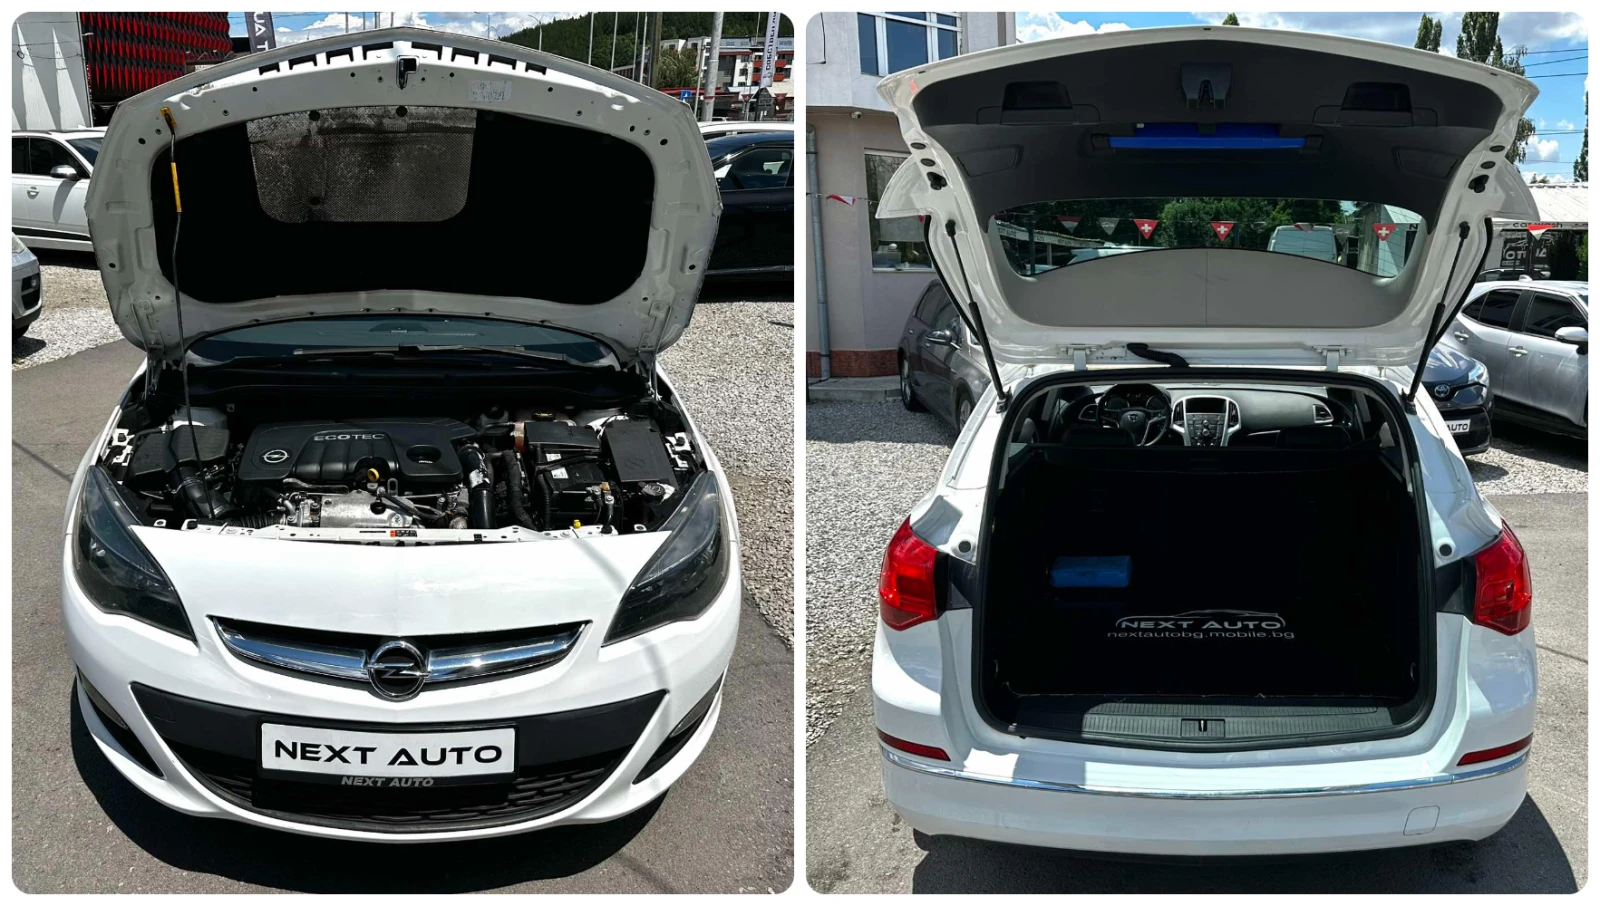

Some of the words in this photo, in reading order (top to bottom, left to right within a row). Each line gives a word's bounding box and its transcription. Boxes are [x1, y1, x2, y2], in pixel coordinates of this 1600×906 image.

[313, 433, 385, 441] ECOTEC
[274, 739, 377, 764] NEXT
[387, 745, 503, 766] AUTO
[341, 776, 385, 787] NEXT
[389, 777, 434, 787] AUTO
